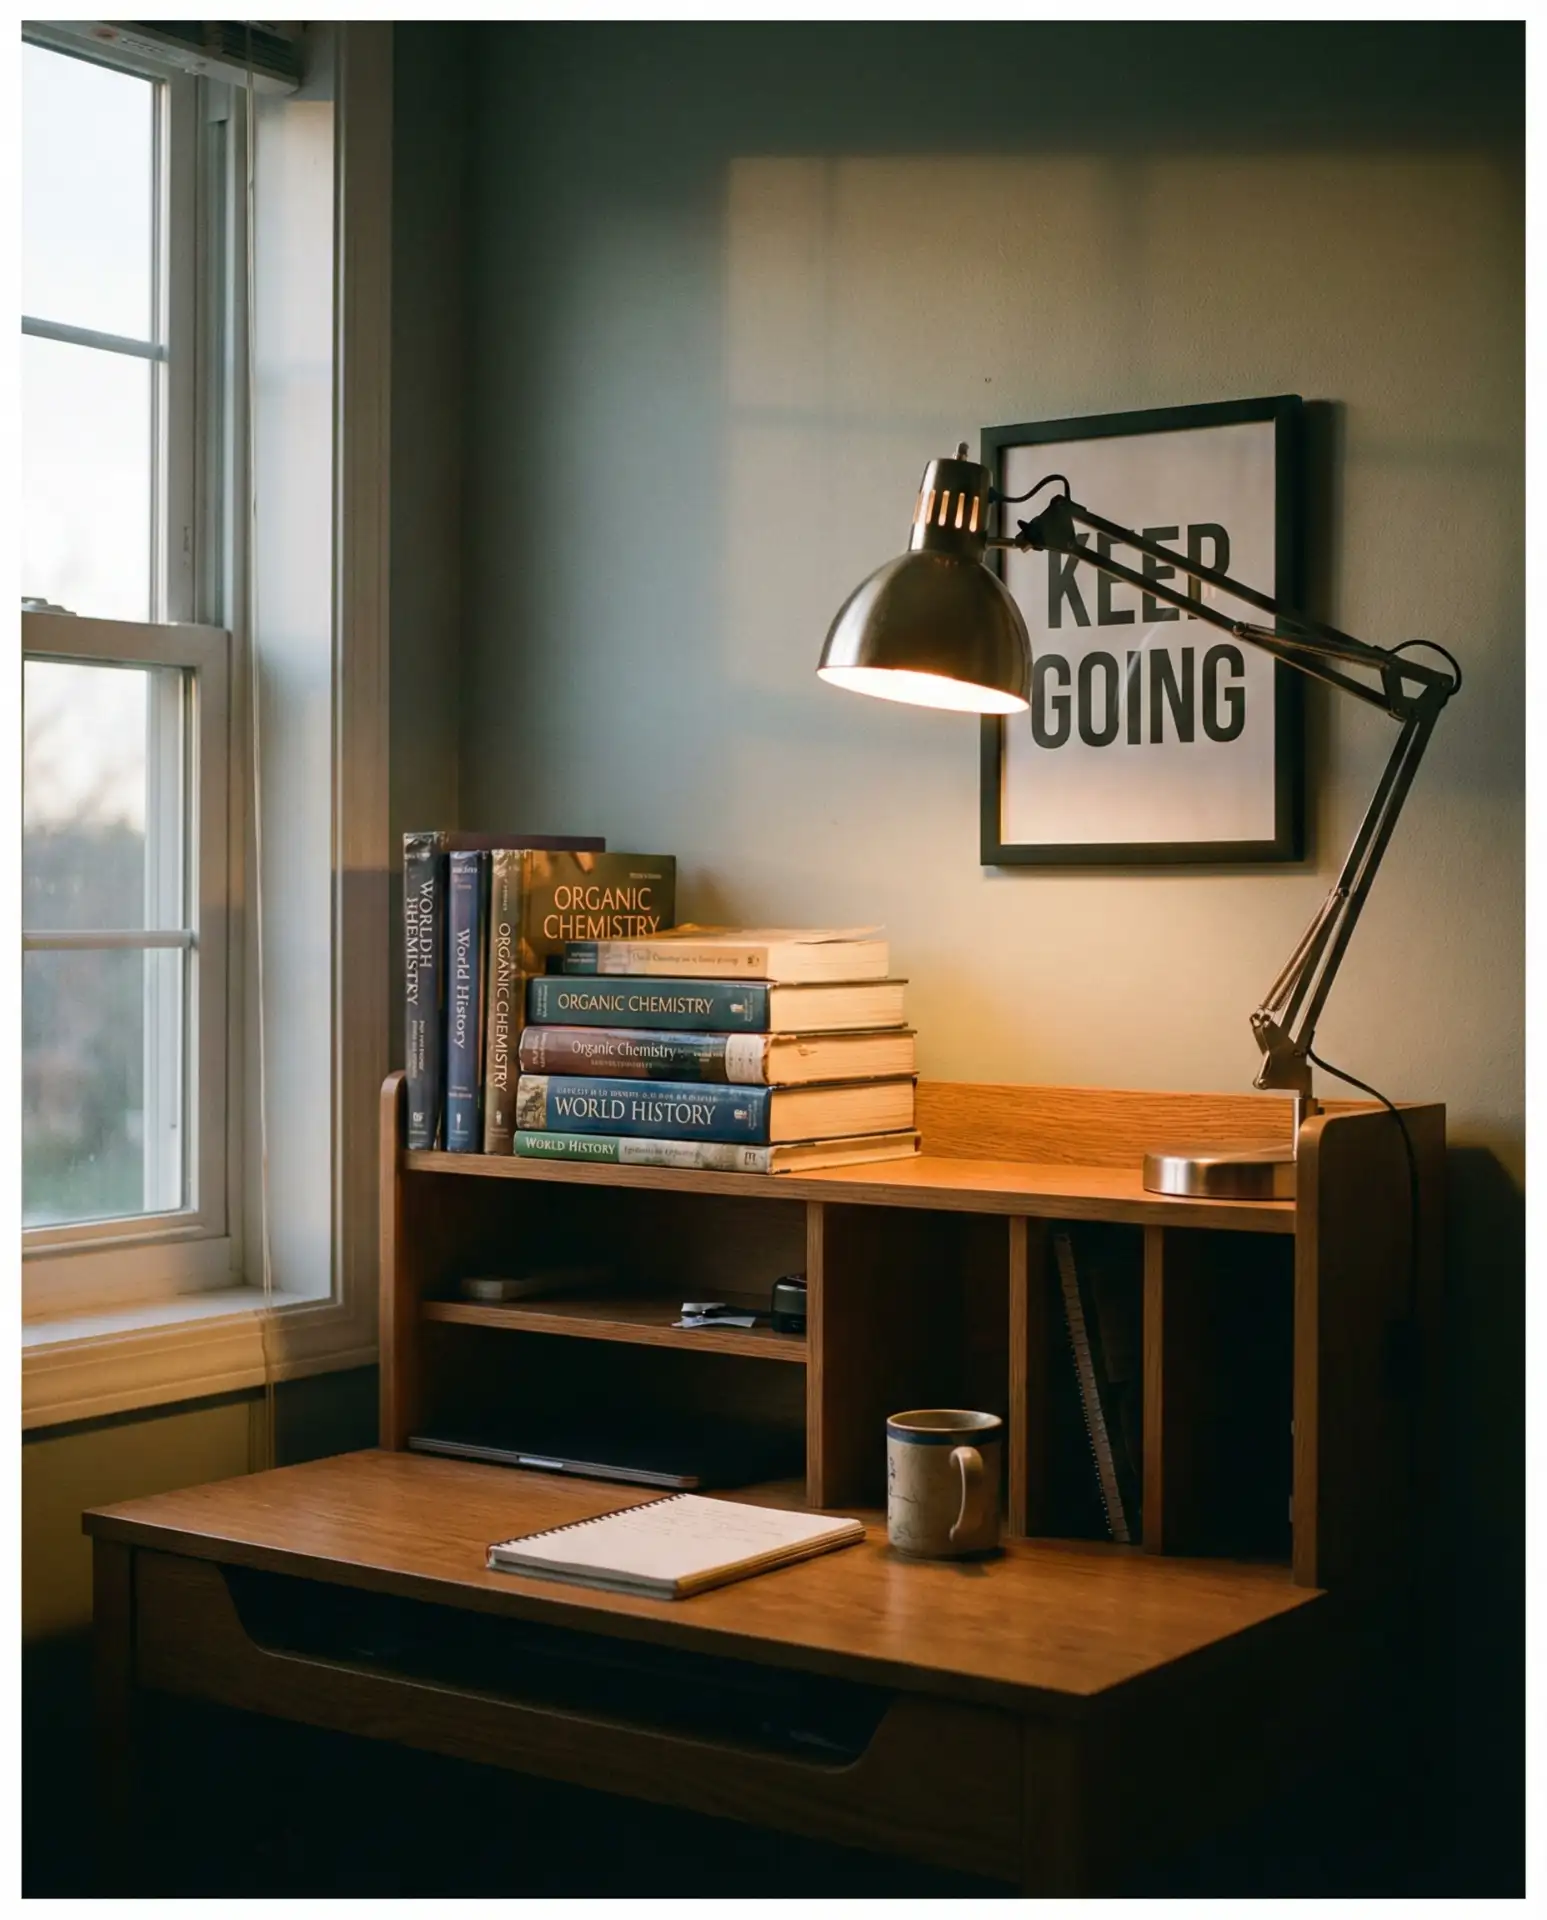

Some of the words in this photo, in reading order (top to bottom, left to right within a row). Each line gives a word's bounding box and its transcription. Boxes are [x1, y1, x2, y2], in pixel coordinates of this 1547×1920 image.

[1048, 523, 1230, 629] KEEP
[1031, 644, 1246, 749] GOING
[554, 885, 652, 911] ORGANIC
[457, 927, 471, 980] World
[543, 914, 661, 940] CHEMISTRY
[497, 923, 512, 999] ORGANIC
[453, 985, 470, 1050] History
[558, 993, 625, 1012] ORGANIC
[628, 995, 714, 1015] CHEMISTRY
[494, 1000, 510, 1092] CHEMISTRY
[572, 1040, 614, 1058] Organic
[617, 1041, 677, 1062] Chemistry
[555, 1096, 626, 1120] WORLD
[631, 1100, 717, 1126] HISTORY
